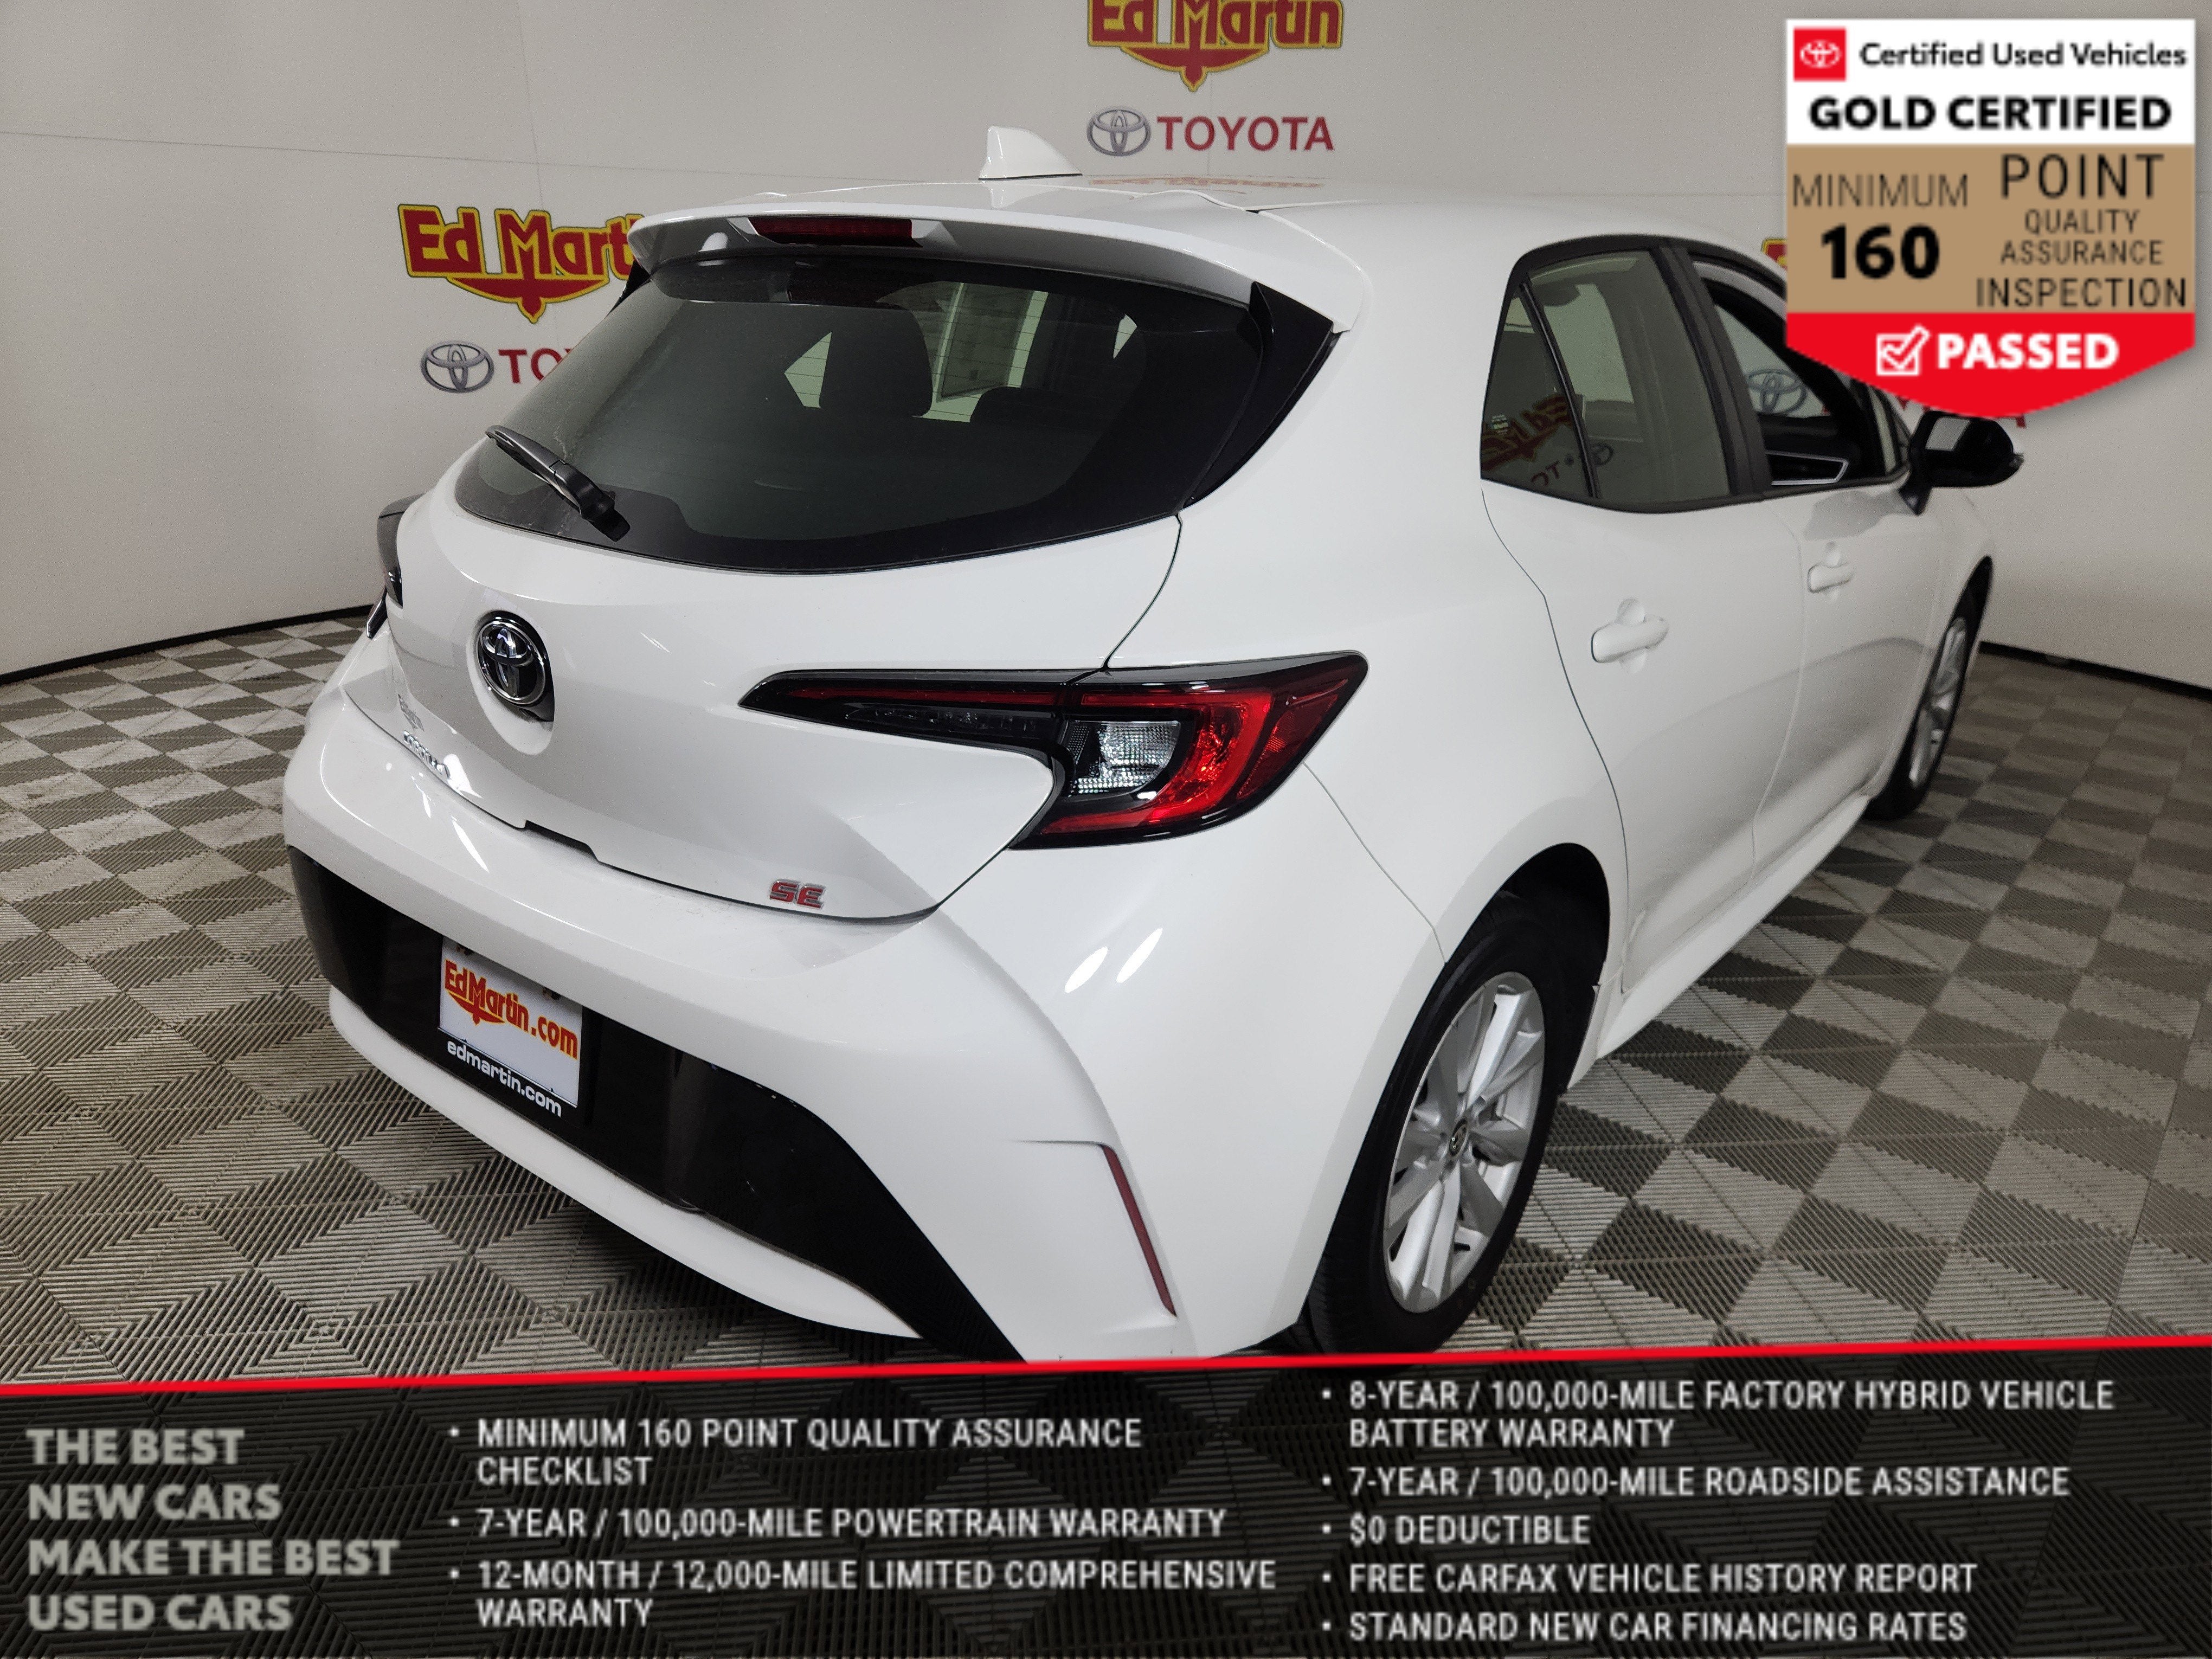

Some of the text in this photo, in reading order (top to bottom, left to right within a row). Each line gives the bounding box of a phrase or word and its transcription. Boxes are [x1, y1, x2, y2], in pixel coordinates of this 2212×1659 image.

[1087, 0, 1343, 47] Ed Martin
[1157, 115, 1334, 151] TOYOTA
[400, 204, 645, 280] Ed Mart
[770, 878, 826, 909] SE
[445, 958, 578, 1061] EdMartin.com
[447, 1040, 563, 1118] edmartin.com
